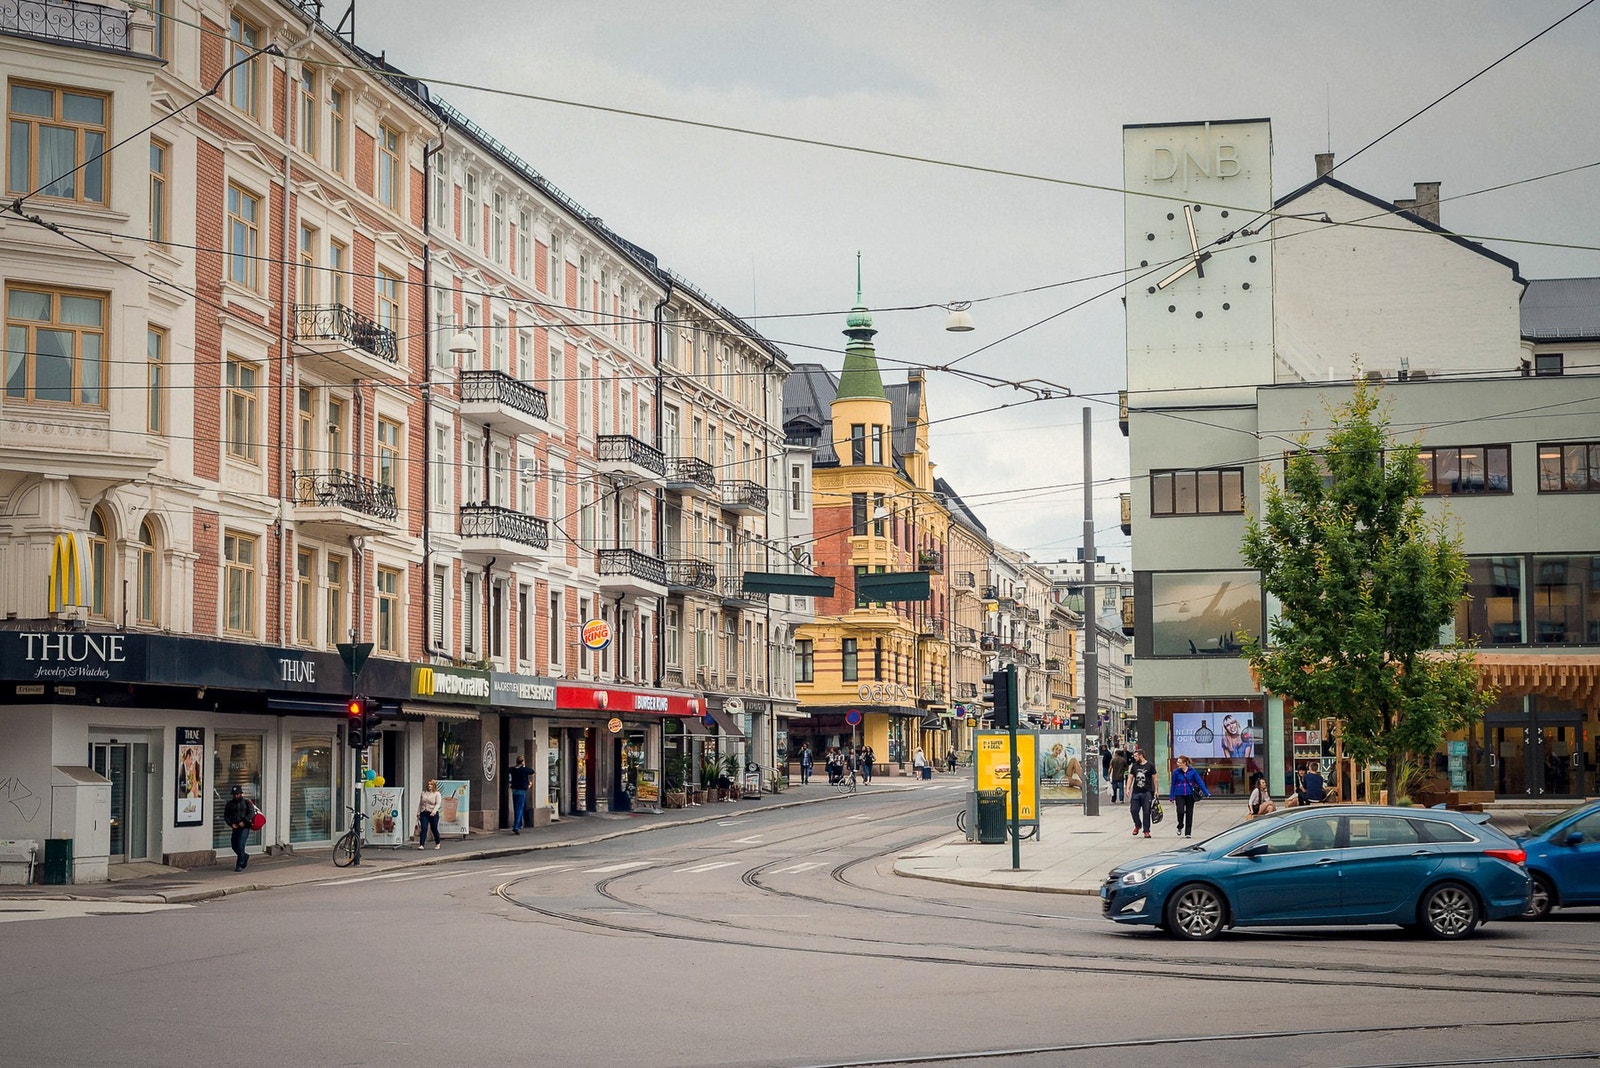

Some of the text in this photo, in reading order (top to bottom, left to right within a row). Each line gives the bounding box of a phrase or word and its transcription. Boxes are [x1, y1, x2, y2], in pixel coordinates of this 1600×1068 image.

[1151, 122, 1242, 192] DNB
[584, 624, 607, 635] BURGER
[585, 629, 608, 643] KING
[20, 633, 126, 662] THUNE
[79, 664, 110, 678] Watches
[279, 658, 315, 683] THUNE
[433, 672, 490, 697] McDonald's
[635, 695, 668, 711] BURGER KING
[184, 729, 200, 740] THUNE
